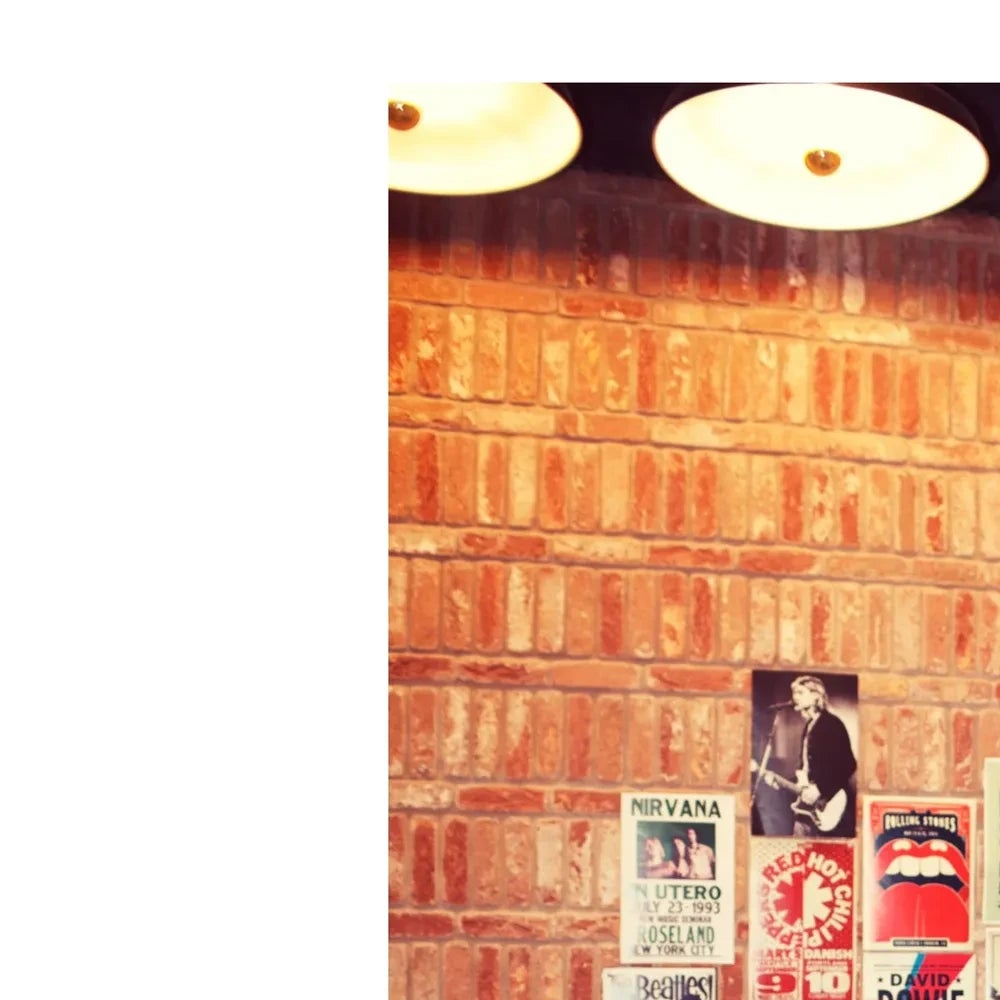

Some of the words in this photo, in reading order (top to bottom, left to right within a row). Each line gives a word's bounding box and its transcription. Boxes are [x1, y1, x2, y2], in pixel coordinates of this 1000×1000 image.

[631, 798, 721, 818] NIRVANA
[885, 815, 920, 831] ROLLING
[923, 816, 957, 833] STONES
[762, 851, 804, 882] RED
[807, 851, 848, 883] HOT
[656, 884, 721, 899] UTERO
[819, 885, 852, 942] CHILI
[637, 925, 714, 943] ROSELAND
[631, 945, 650, 955] EW
[657, 945, 685, 955] YORK
[691, 945, 715, 955] CITY
[804, 949, 853, 959] DANISH
[757, 974, 796, 994] 9
[805, 971, 850, 994] 10
[891, 973, 950, 986] DAVID
